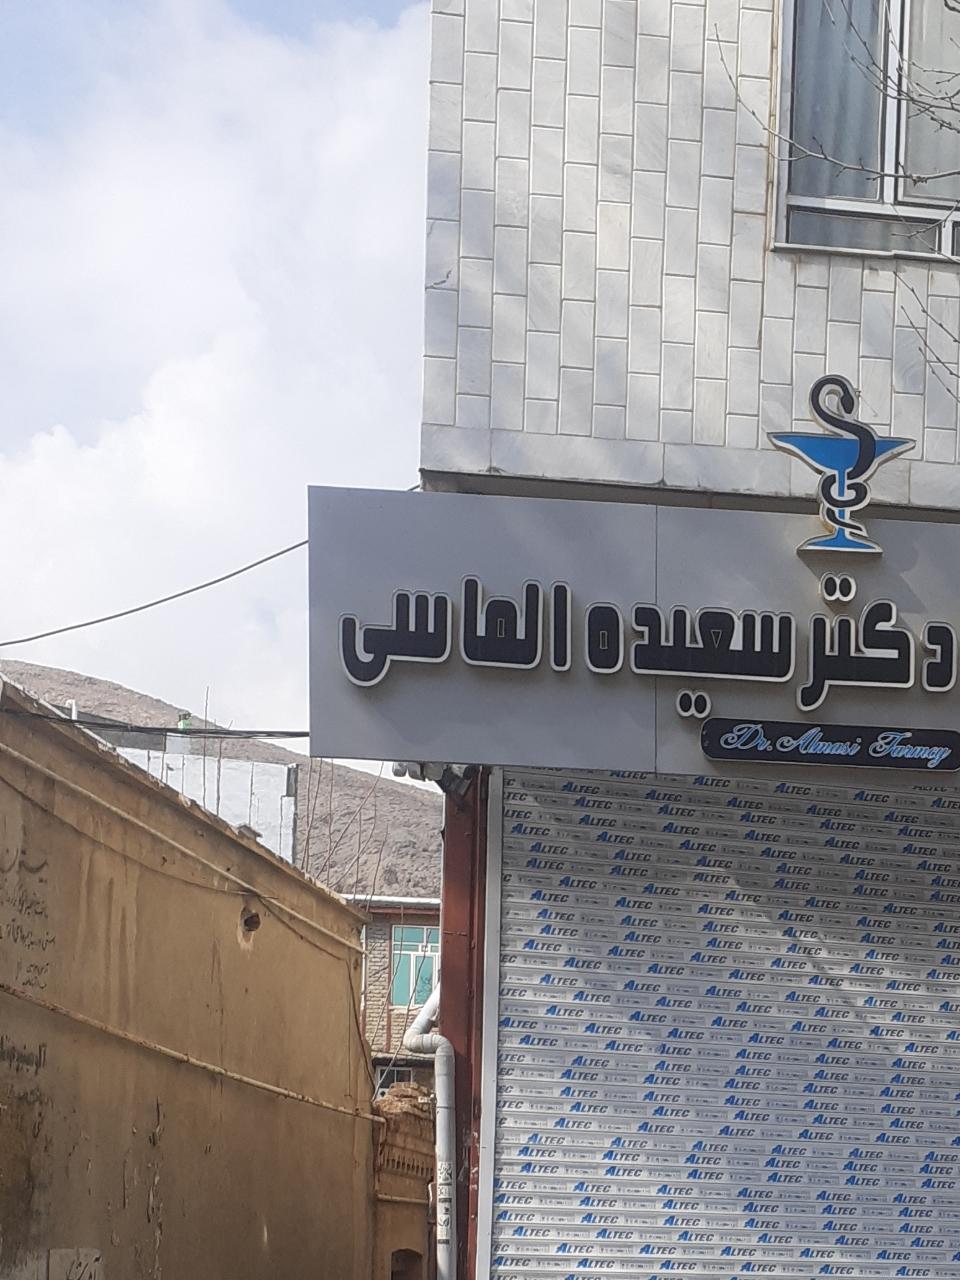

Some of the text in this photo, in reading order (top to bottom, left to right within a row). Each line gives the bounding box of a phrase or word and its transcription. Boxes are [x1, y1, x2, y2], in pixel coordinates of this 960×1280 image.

[339, 574, 571, 687] الماسی
[797, 573, 957, 713] دکتر
[586, 603, 797, 719] سعیده
[720, 724, 772, 751] Dr.
[776, 726, 862, 756] Almasi
[645, 788, 683, 803] ALTEC
[726, 796, 765, 810] ALTEC
[805, 803, 844, 817] ALTEC
[883, 810, 921, 824] ALTEC
[679, 838, 717, 853] ALTEC
[760, 846, 798, 860] ALTEC
[838, 853, 877, 867] ALTEC
[915, 859, 954, 873] ALTEC
[620, 914, 659, 928] ALTEC
[523, 939, 562, 952] ALTEC
[706, 936, 744, 950] ALTEC
[864, 949, 900, 961] ALTEC
[646, 963, 685, 976] ALTEC
[770, 957, 808, 970] ALTEC
[572, 990, 611, 1004] ALTEC
[629, 1010, 668, 1024] ALTEC
[711, 1015, 749, 1029] ALTEC
[891, 1011, 926, 1024] ALTEC
[790, 1020, 829, 1034] ALTEC
[517, 1034, 560, 1048] ALTEC
[735, 1048, 773, 1061] ALTEC
[654, 1059, 693, 1073] ALTEC
[891, 1057, 927, 1070] ALTEC
[814, 1068, 849, 1081] ALTEC
[560, 1085, 598, 1099] ALTEC
[724, 1094, 762, 1107] ALTEC
[637, 1120, 676, 1134] ALTEC
[797, 1128, 835, 1141] ALTEC
[875, 1132, 911, 1145] ALTEC
[516, 1146, 558, 1159] ALTEC
[683, 1154, 722, 1166] ALTEC
[573, 1180, 612, 1194] ALTEC
[736, 1186, 775, 1200] ALTEC
[816, 1189, 851, 1202] ALTEC
[892, 1192, 928, 1205] ALTEC
[661, 1199, 700, 1211] ALTEC
[512, 1225, 551, 1238] ALTEC
[595, 1228, 634, 1240] ALTEC
[757, 1233, 793, 1245] ALTEC
[834, 1234, 870, 1247] ALTEC
[895, 1265, 931, 1277] ALTEC
